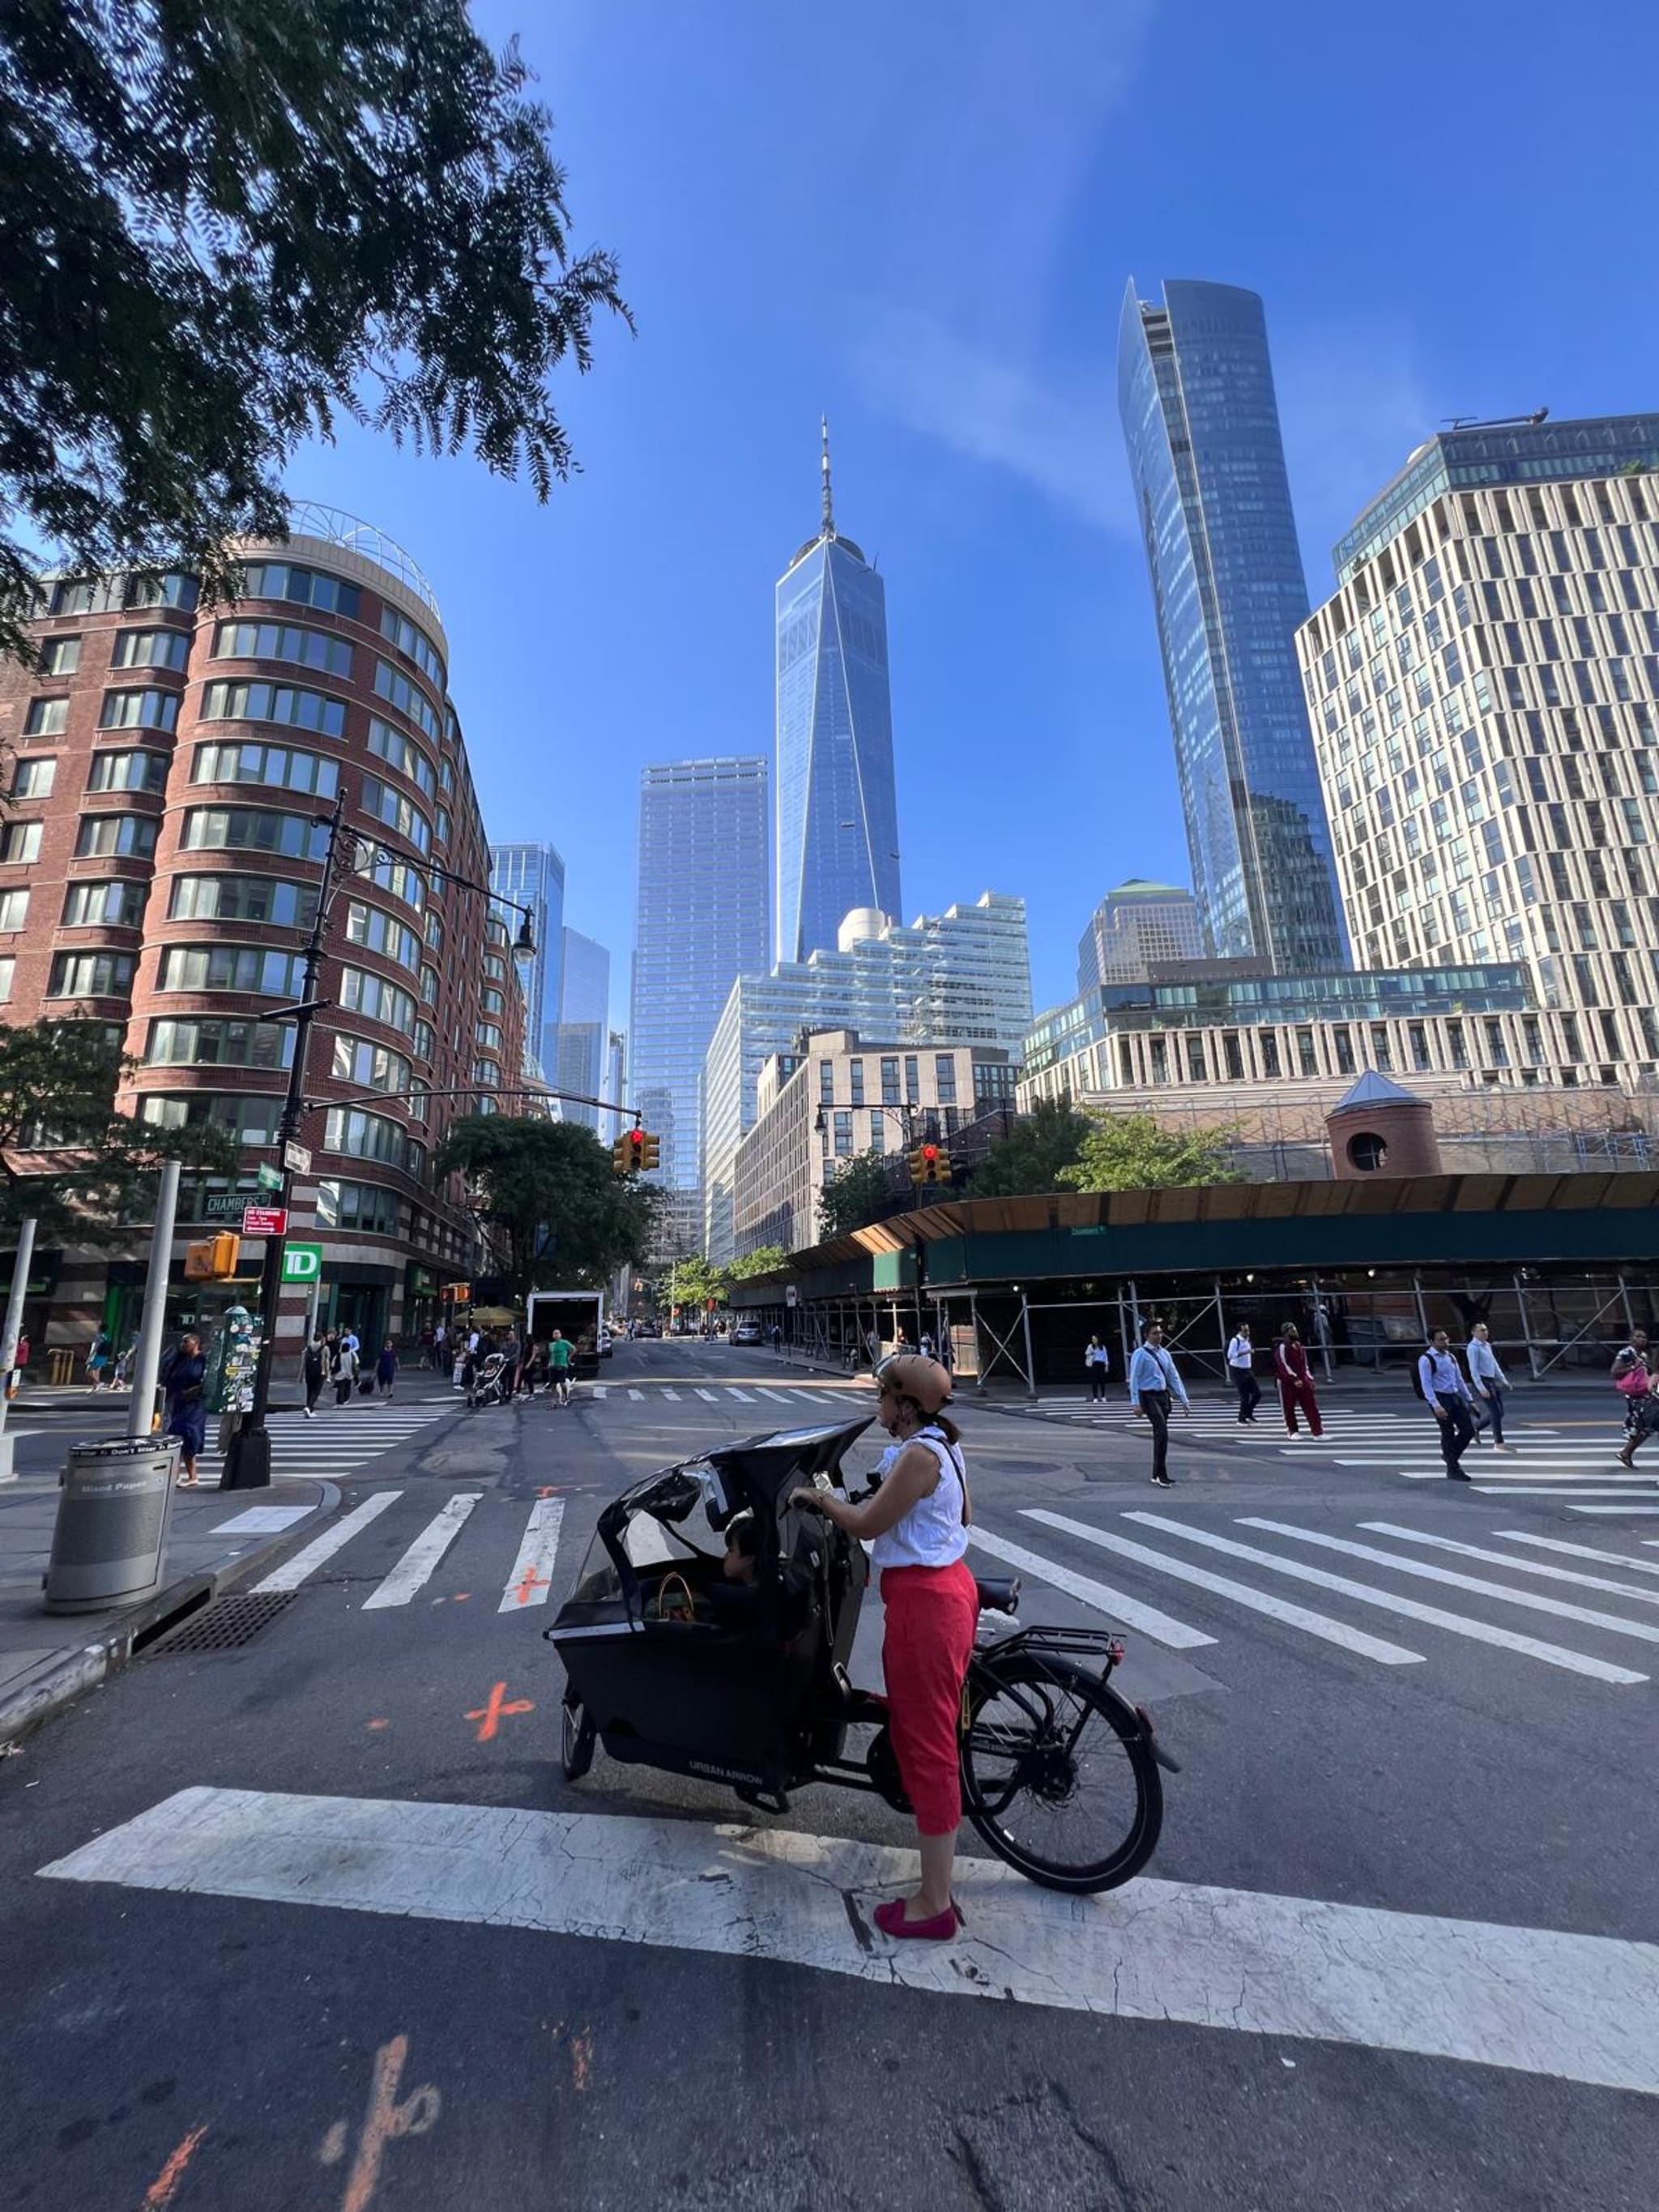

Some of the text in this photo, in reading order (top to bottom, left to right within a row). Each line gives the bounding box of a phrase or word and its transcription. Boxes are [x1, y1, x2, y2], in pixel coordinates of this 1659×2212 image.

[284, 1251, 318, 1275] TD
[689, 1760, 764, 1785] URBAN ARROW
